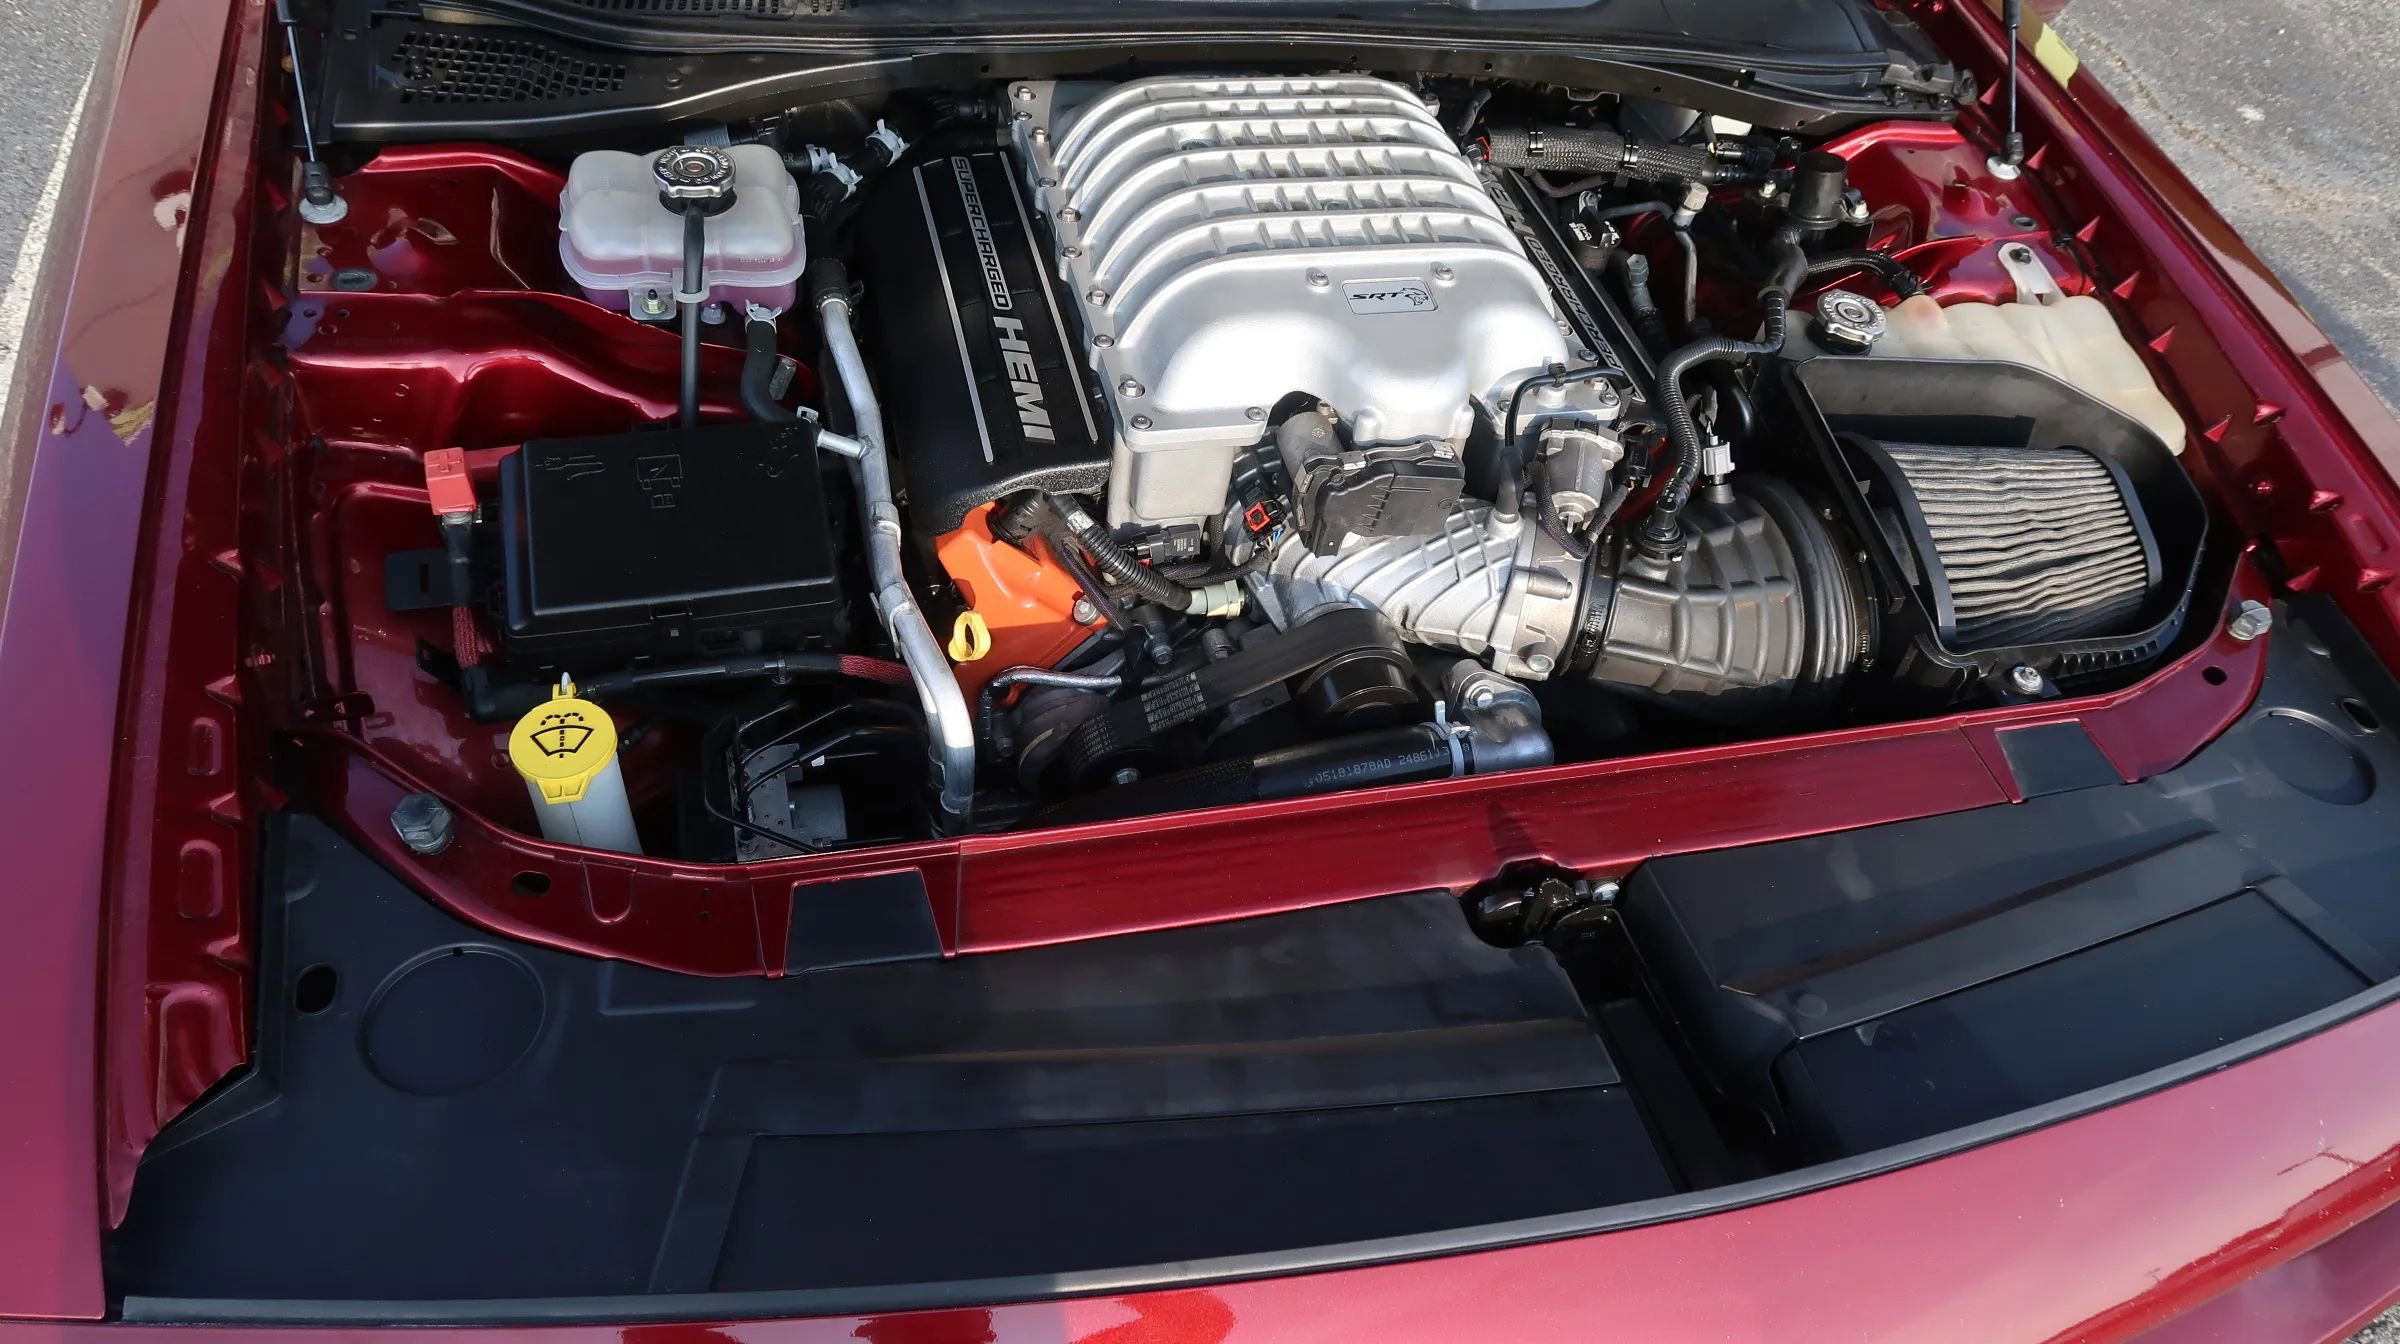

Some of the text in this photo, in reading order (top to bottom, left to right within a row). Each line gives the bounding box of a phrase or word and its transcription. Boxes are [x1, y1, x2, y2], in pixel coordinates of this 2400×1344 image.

[953, 157, 1055, 442] SUPERCHARGED HEMI
[1350, 291, 1403, 301] SRT
[1529, 238, 1622, 369] PERCHARGED
